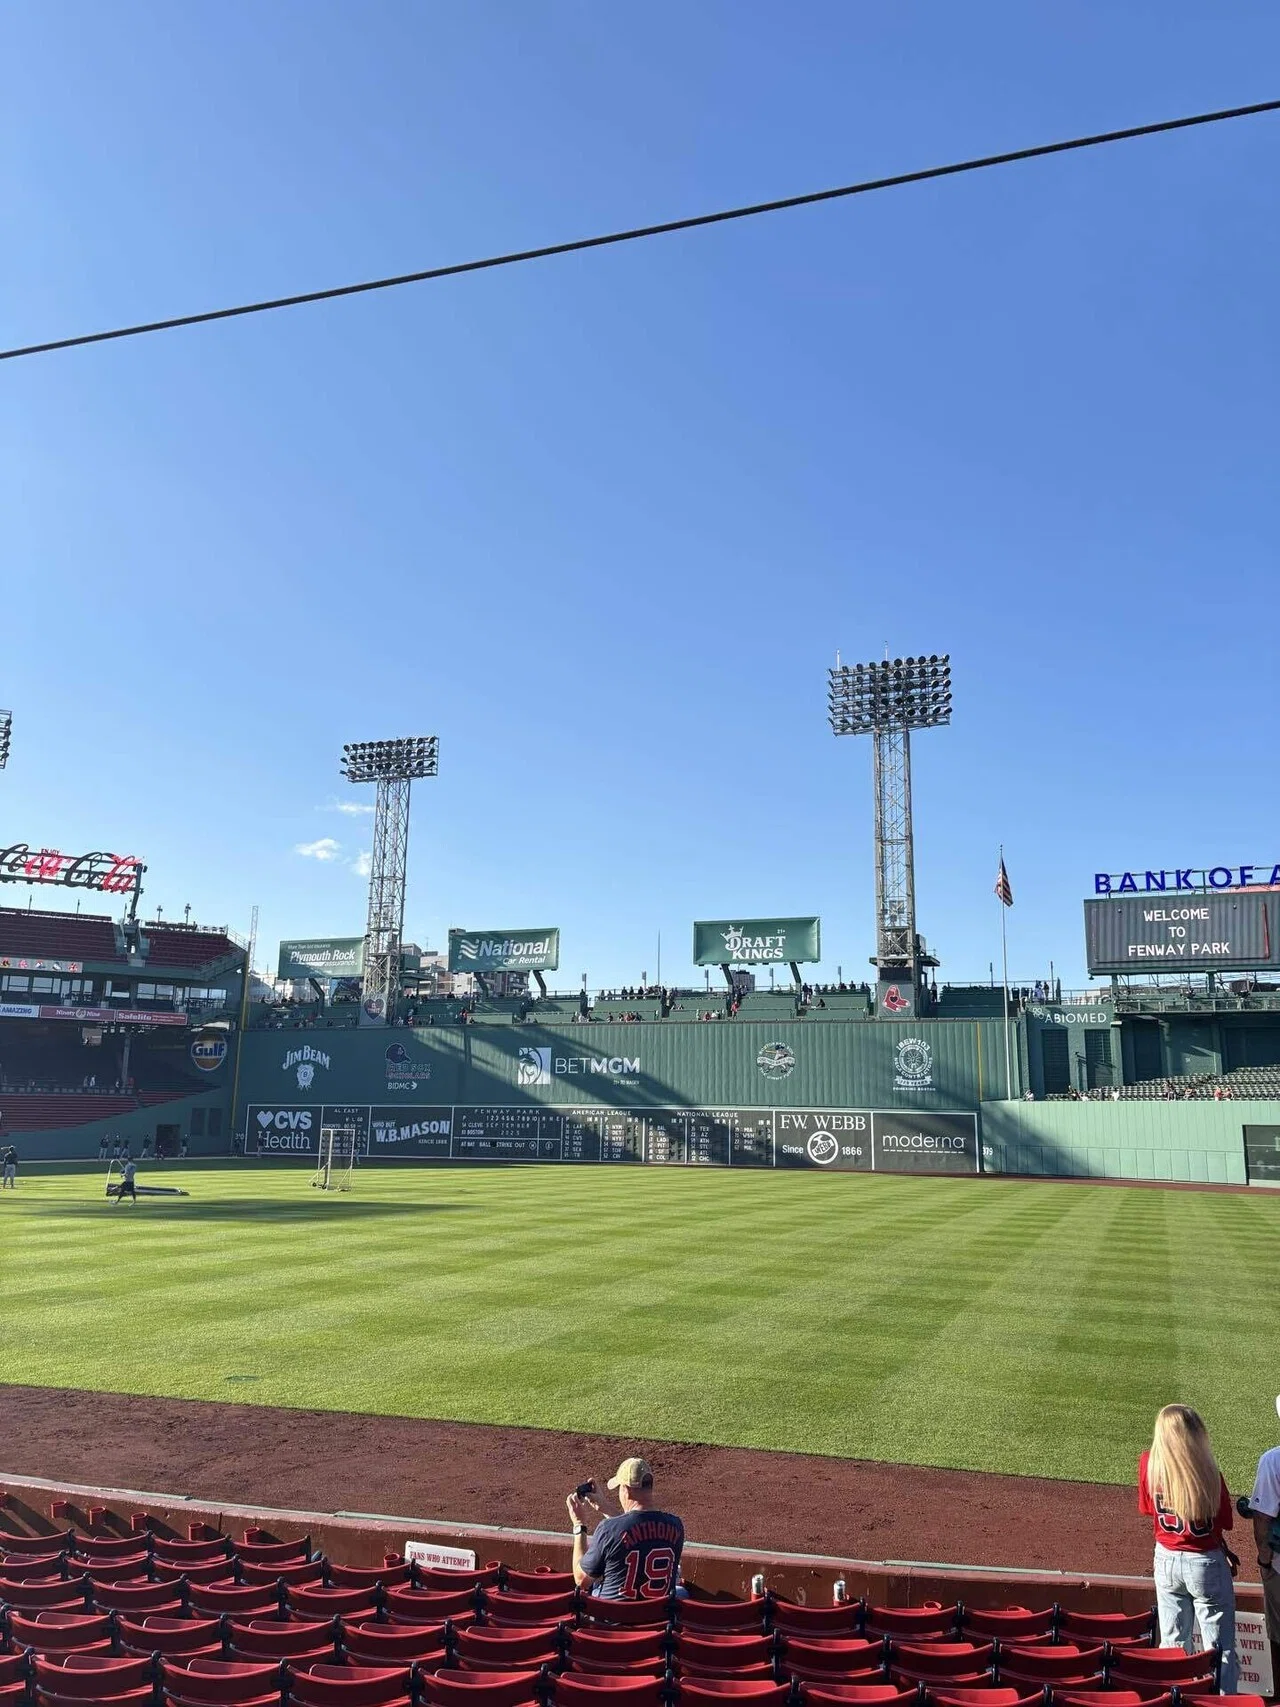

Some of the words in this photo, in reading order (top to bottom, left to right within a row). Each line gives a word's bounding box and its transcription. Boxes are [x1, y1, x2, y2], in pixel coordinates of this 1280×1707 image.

[1095, 868, 1196, 894] BANK
[1208, 865, 1255, 888] OF
[1144, 908, 1209, 922] WELCOME
[1168, 926, 1186, 938] TO
[725, 936, 786, 951] DRAFT
[1128, 943, 1185, 957] FENWAY
[1191, 942, 1230, 955] PARK
[289, 950, 331, 964] Plymouth
[332, 948, 356, 961] Rock
[502, 957, 516, 965] Car
[518, 956, 546, 964] Rental
[732, 947, 784, 960] KINGS
[1045, 1013, 1107, 1024] ABIOMED
[192, 1042, 225, 1057] Gulf
[896, 1038, 917, 1051] IBEW
[917, 1039, 930, 1051] 103
[282, 1050, 302, 1070] JIM
[302, 1045, 331, 1070] BEAM
[555, 1057, 640, 1074] BETMGM
[387, 1082, 410, 1090] BIDMC
[275, 1110, 312, 1130] CVS
[813, 1114, 866, 1131] WEBB
[257, 1130, 311, 1149] Health
[882, 1132, 966, 1149] moderna
[782, 1144, 804, 1154] Since
[841, 1146, 862, 1156] 1866
[409, 1551, 425, 1560] FANS
[426, 1553, 441, 1563] WHO
[441, 1556, 471, 1568] ATTEMPT
[618, 1547, 675, 1599] 19
[1240, 1638, 1265, 1651] WITH
